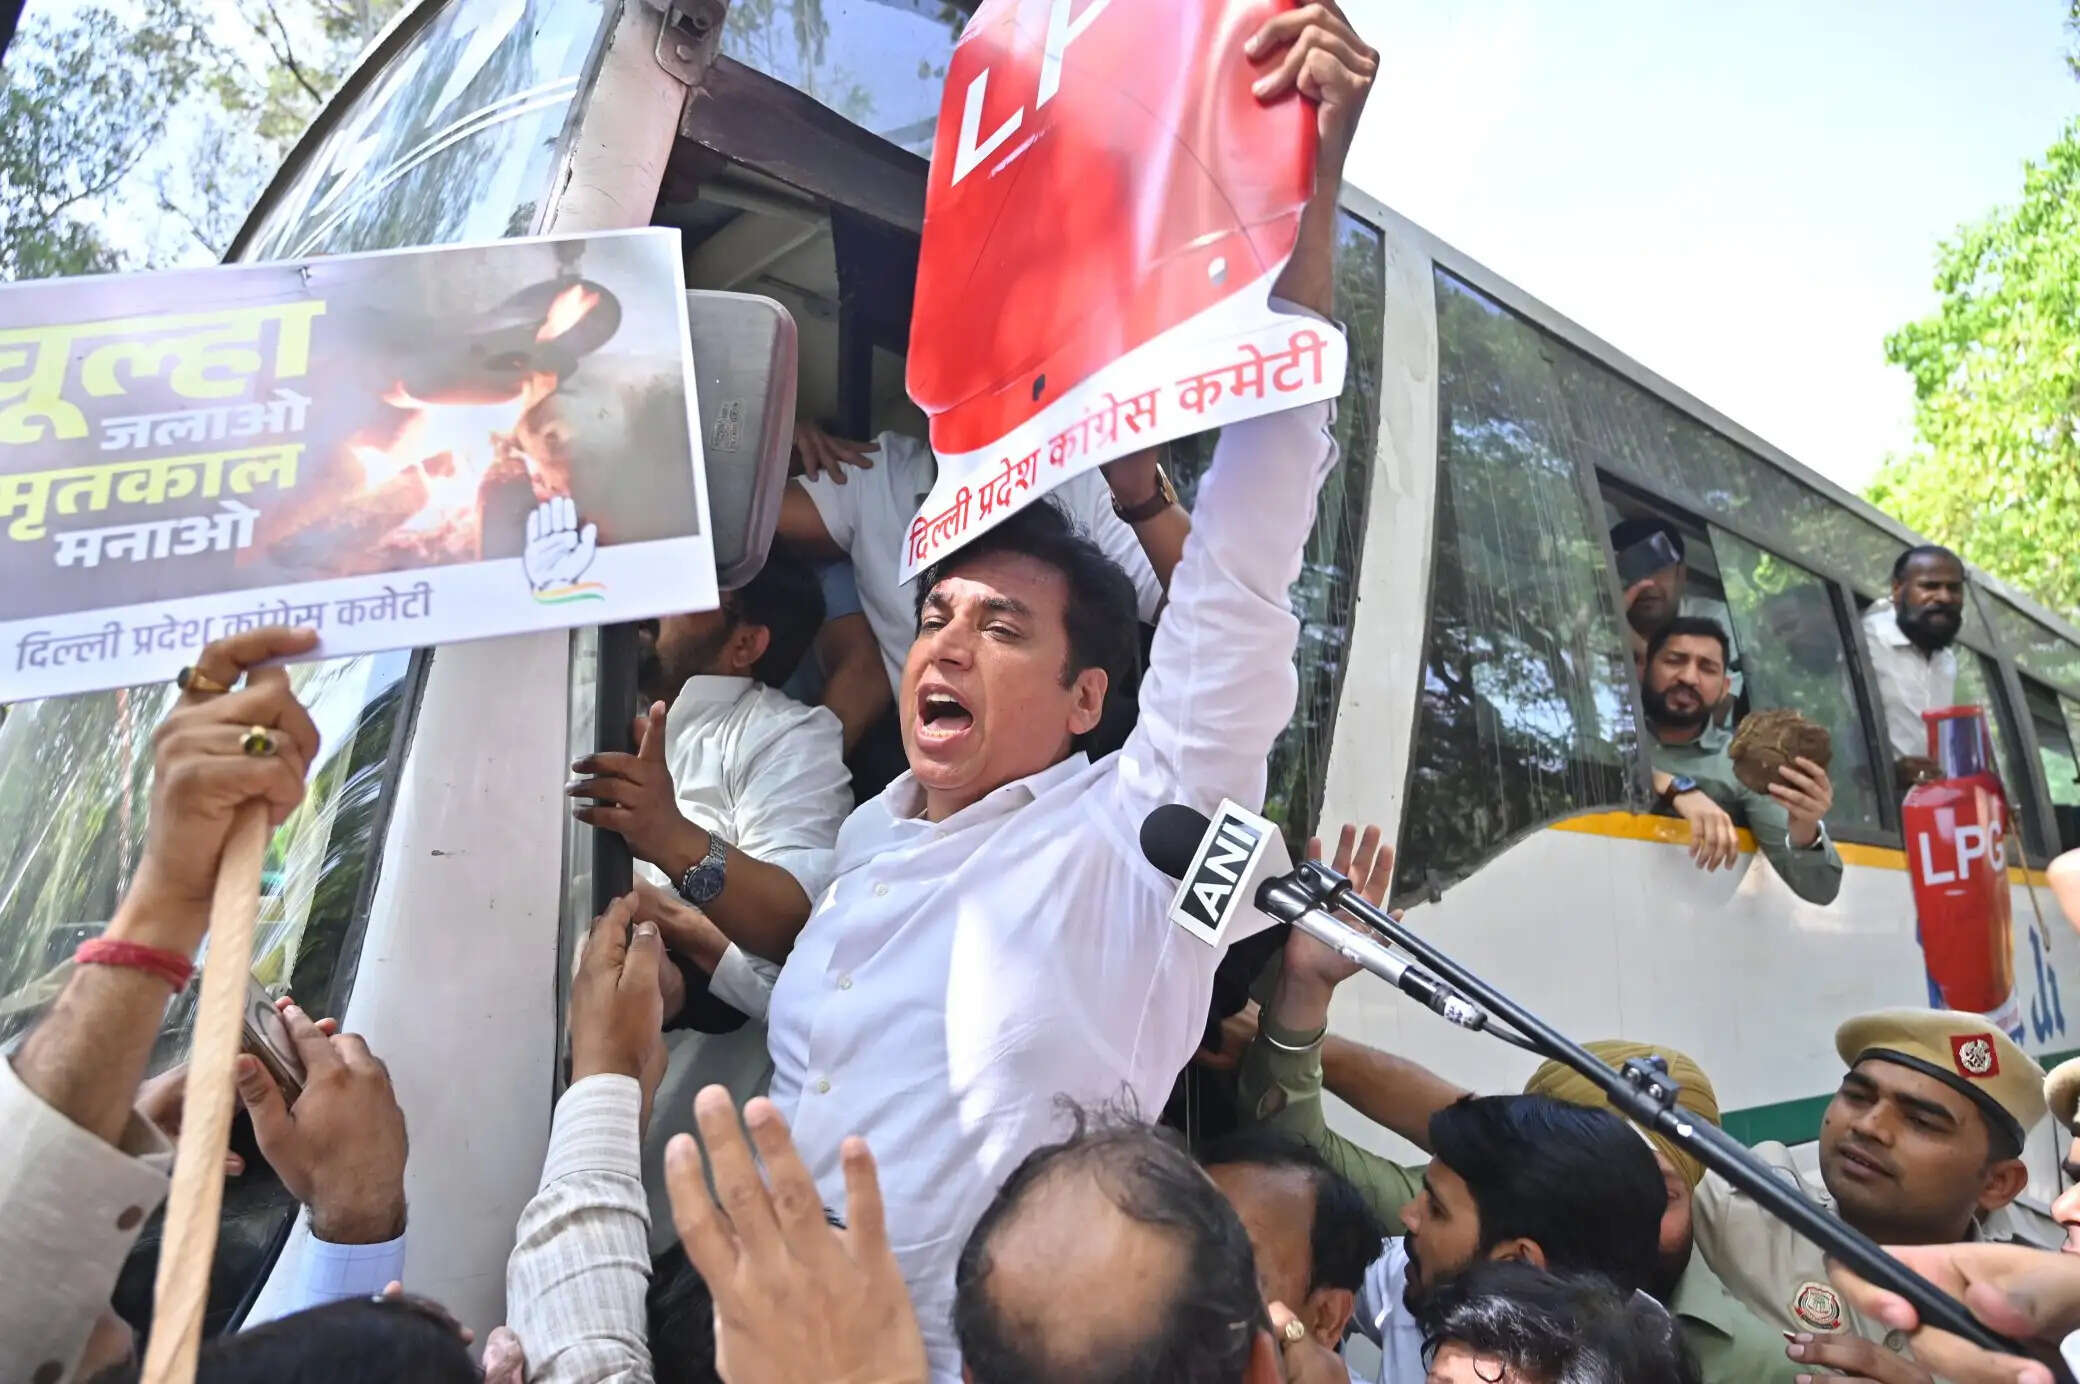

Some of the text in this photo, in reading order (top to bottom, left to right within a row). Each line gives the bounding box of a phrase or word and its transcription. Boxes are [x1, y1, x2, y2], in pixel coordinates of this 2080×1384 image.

[101, 387, 312, 450] जलाओ
[907, 329, 1328, 567] दिल्ली प्रदेश कांग्रेस कमेटी
[53, 499, 261, 568] मनाओ
[16, 621, 125, 672] दिल्ली
[132, 613, 215, 656] प्रदेश
[335, 581, 435, 626] कमेटी
[1192, 820, 1263, 924] ANI
[1918, 818, 2005, 887] LPG
